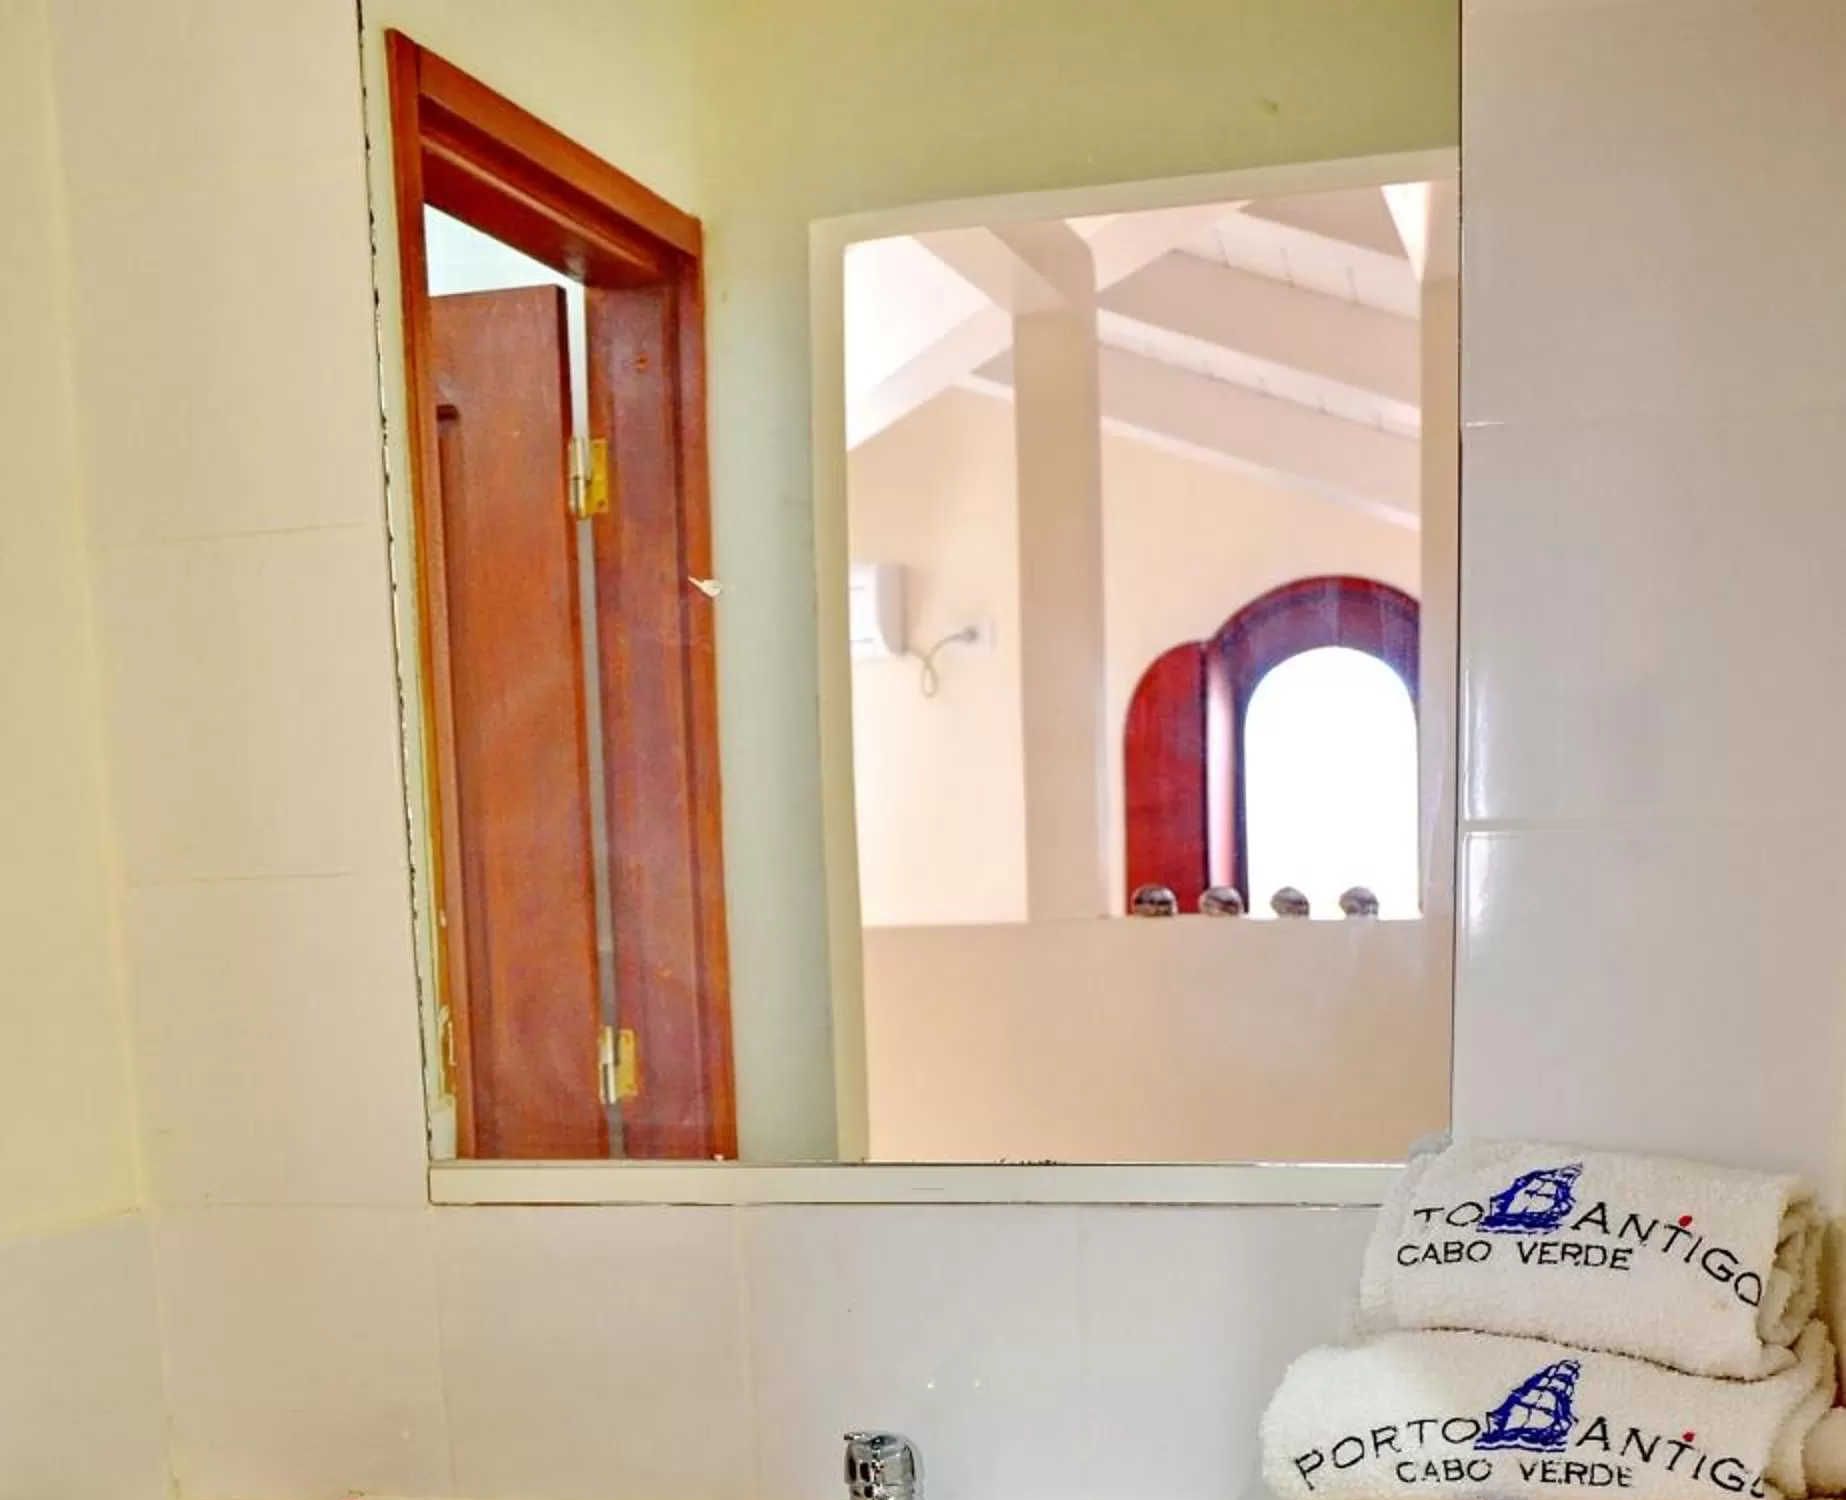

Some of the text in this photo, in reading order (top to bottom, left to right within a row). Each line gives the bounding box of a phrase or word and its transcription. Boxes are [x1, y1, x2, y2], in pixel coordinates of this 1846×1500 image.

[1397, 1240, 1633, 1270] CABO VERDE
[1570, 1201, 1763, 1306] ANTIGO
[1293, 1416, 1482, 1491] PORTO
[1395, 1458, 1634, 1488] CABO VERDE
